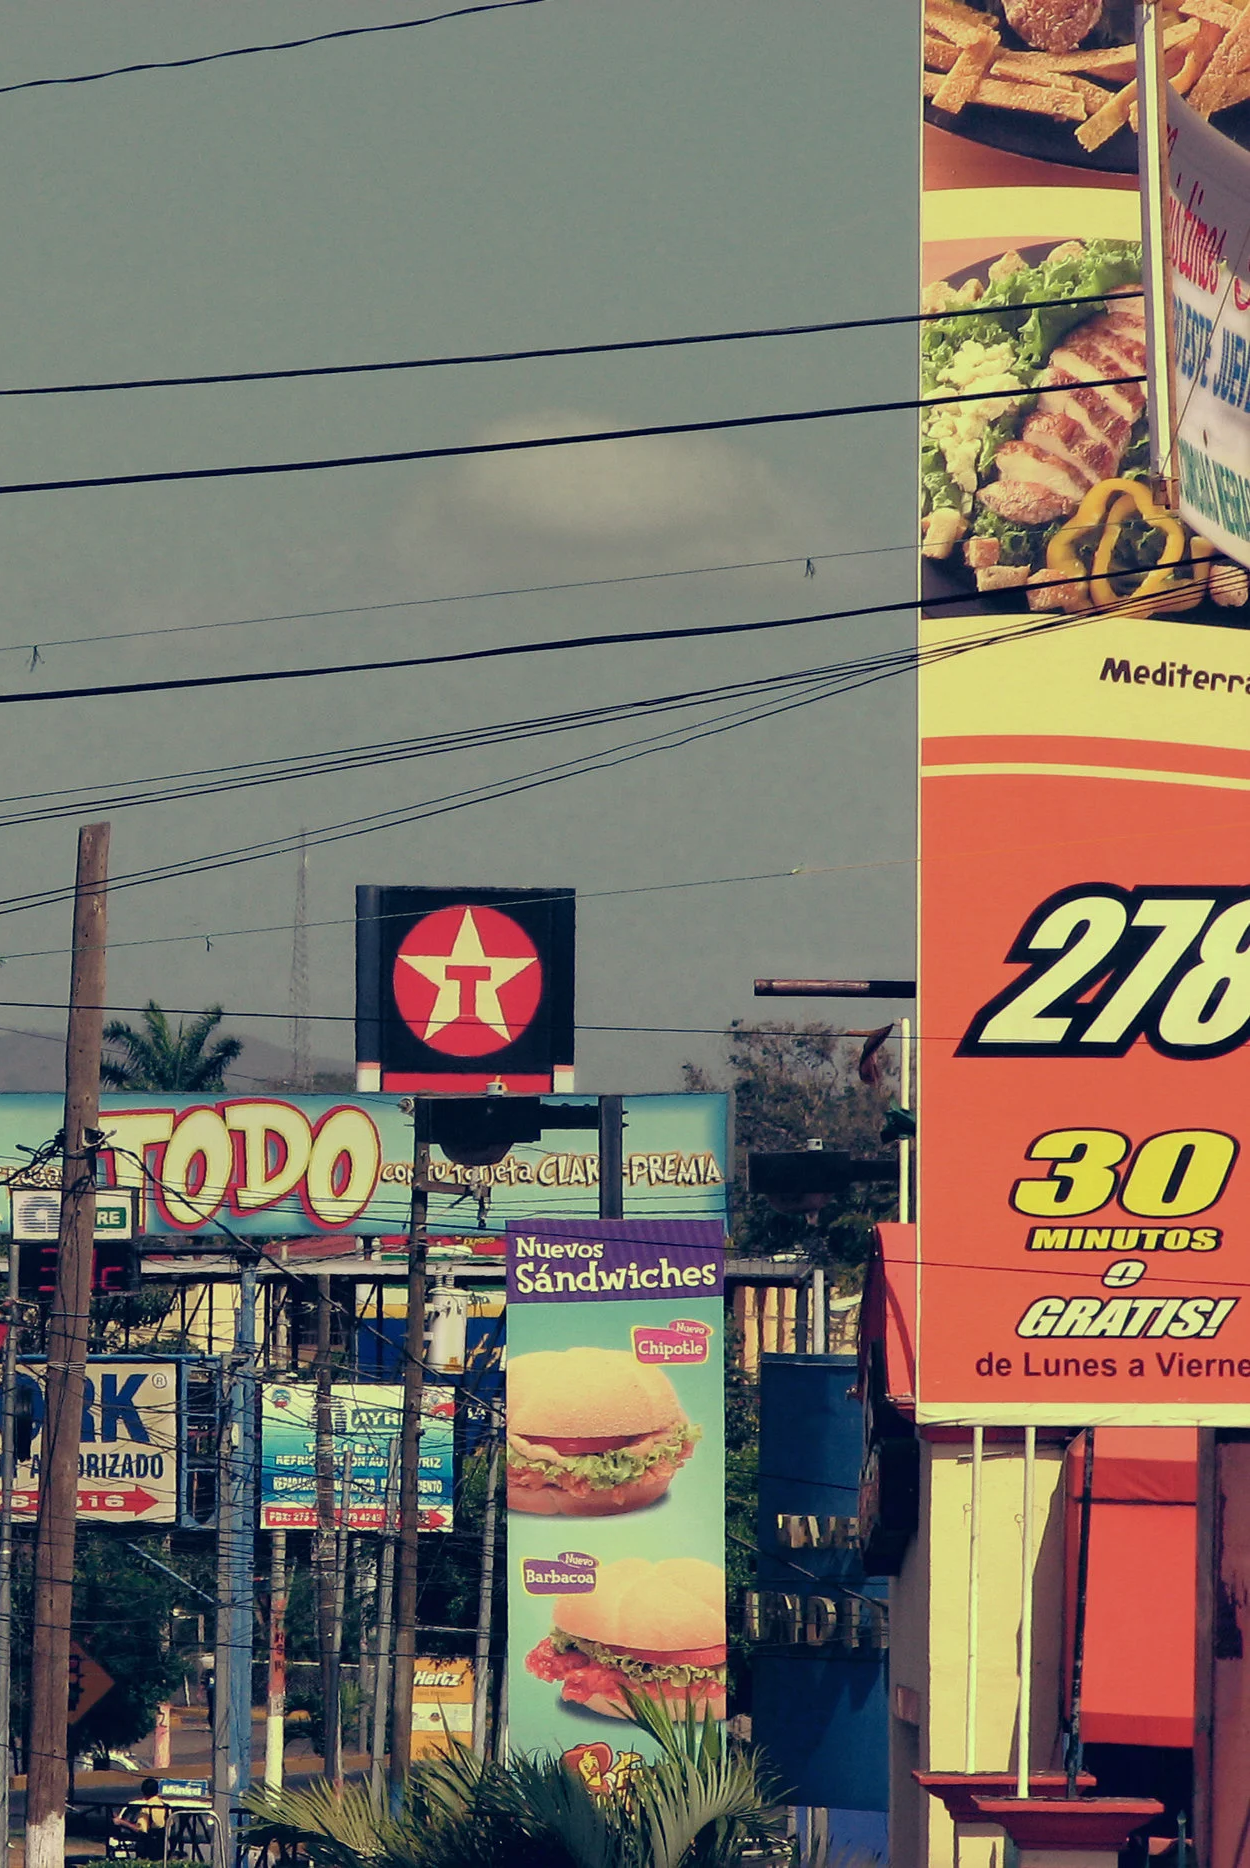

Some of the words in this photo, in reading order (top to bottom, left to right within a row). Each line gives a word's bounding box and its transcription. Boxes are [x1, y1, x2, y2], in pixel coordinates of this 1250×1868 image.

[953, 881, 1250, 1058] 278
[97, 1097, 383, 1232] TODO
[1008, 1127, 1241, 1218] 30
[516, 1236, 605, 1259] Nuevos
[1025, 1227, 1224, 1251] MINUTOS
[515, 1258, 717, 1294] Sándwiches
[676, 1321, 705, 1335] Nuevo
[1016, 1296, 1242, 1338] GRATIS!
[638, 1339, 704, 1360] Chipotle
[976, 1352, 1012, 1377] de
[1024, 1352, 1117, 1377] Lunes
[1128, 1358, 1145, 1377] a
[565, 1553, 594, 1567] Nuevo
[525, 1569, 595, 1584] Barbacoa
[414, 1671, 461, 1686] Hertz
